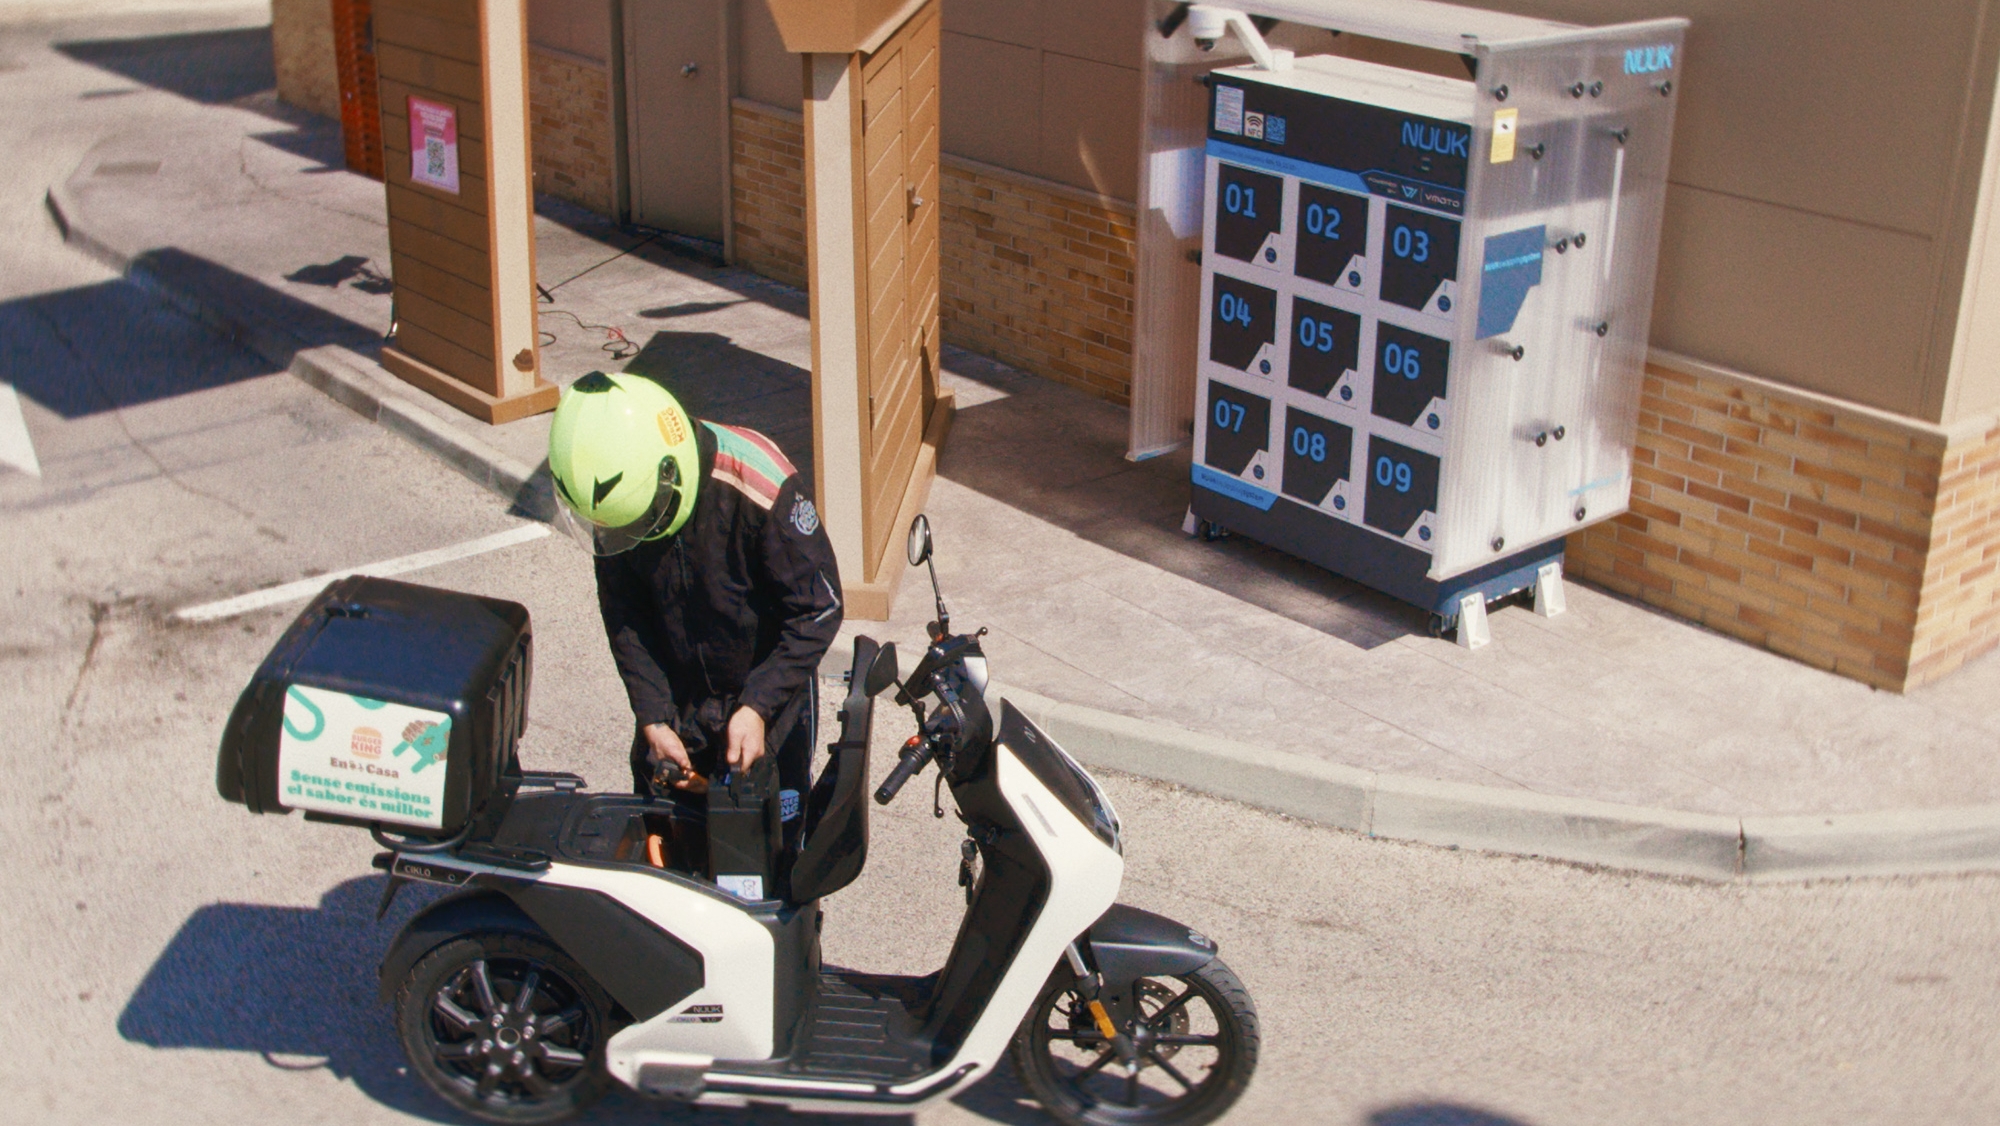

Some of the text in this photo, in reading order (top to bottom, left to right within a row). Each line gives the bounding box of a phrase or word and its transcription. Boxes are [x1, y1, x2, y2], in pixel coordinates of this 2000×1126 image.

[1624, 43, 1674, 75] NUUK
[1247, 127, 1262, 138] NFC
[1402, 121, 1468, 158] NUUK
[1225, 183, 1257, 218] 01
[1306, 203, 1341, 239] 02
[1392, 226, 1430, 263] 03
[1219, 293, 1252, 327] 04
[1299, 316, 1334, 352] 05
[1384, 343, 1421, 380] 06
[665, 406, 685, 443] KING
[1214, 399, 1246, 434] 07
[1292, 427, 1327, 462] 08
[1375, 456, 1412, 493] 09
[351, 742, 382, 755] KING
[352, 734, 382, 745] BURGER
[330, 757, 399, 778] En Casa
[287, 784, 433, 819] el sabor és millor
[290, 769, 431, 805] Sense emissions
[404, 865, 431, 877] CIKLO
